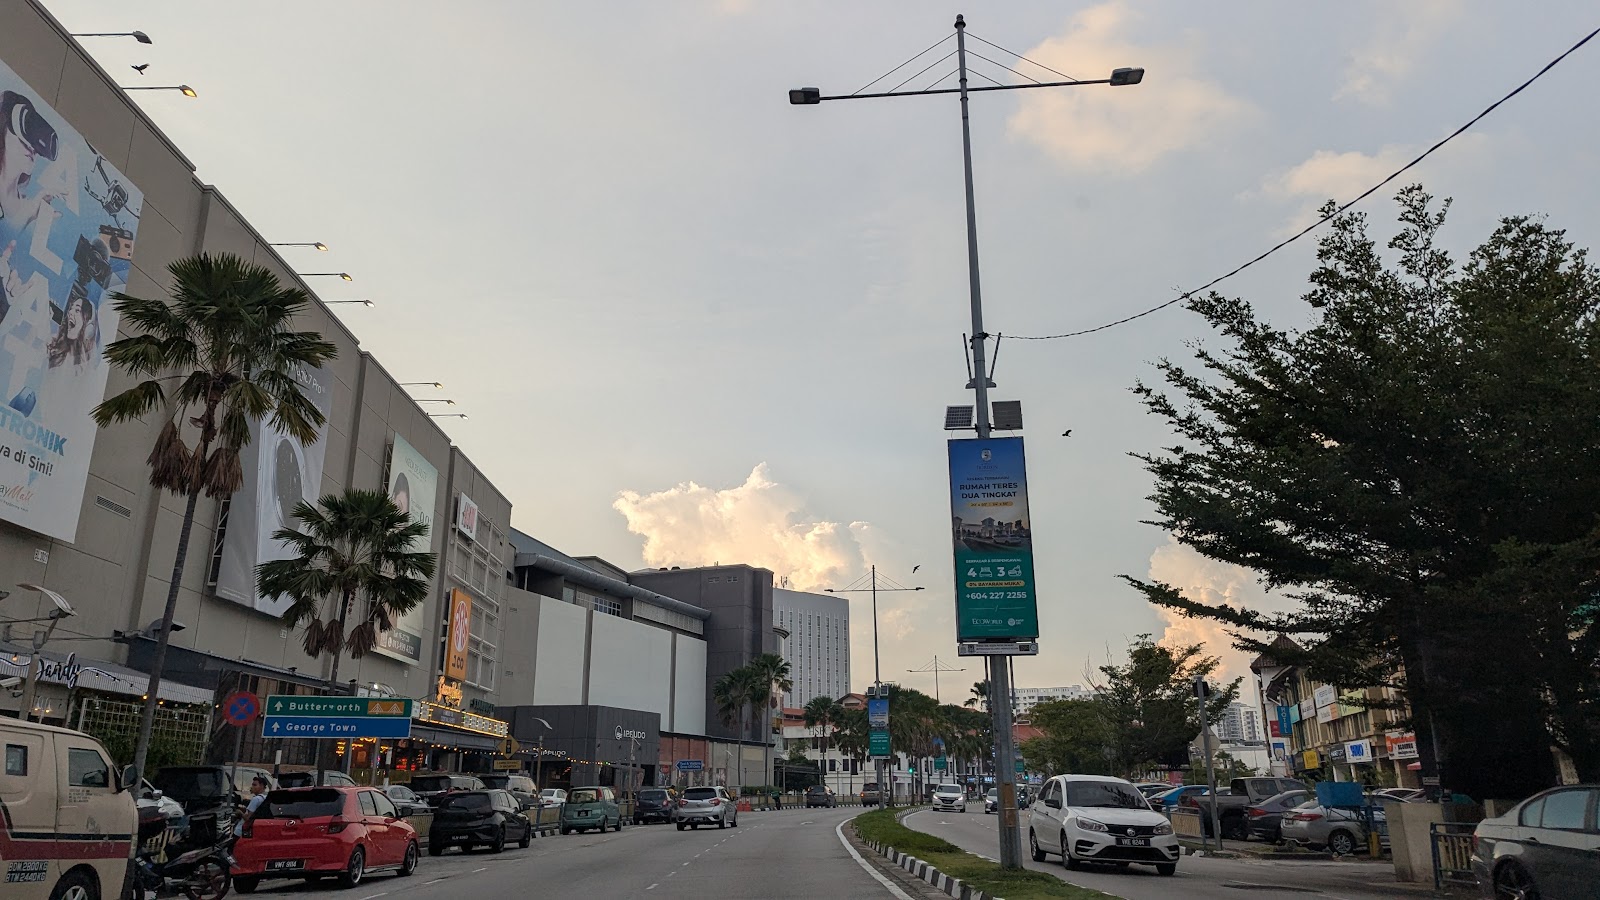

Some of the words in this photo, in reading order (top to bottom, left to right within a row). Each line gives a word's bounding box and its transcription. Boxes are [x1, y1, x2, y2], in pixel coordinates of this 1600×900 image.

[14, 450, 26, 464] di
[28, 456, 53, 477] Sini!
[967, 567, 977, 578] 4
[996, 566, 1006, 577] 3
[966, 592, 988, 600] +604
[1006, 591, 1027, 599] 2255
[288, 702, 361, 712] Butterworth
[1280, 707, 1289, 734] HOTEL
[285, 722, 324, 733] George
[329, 723, 356, 732] Town
